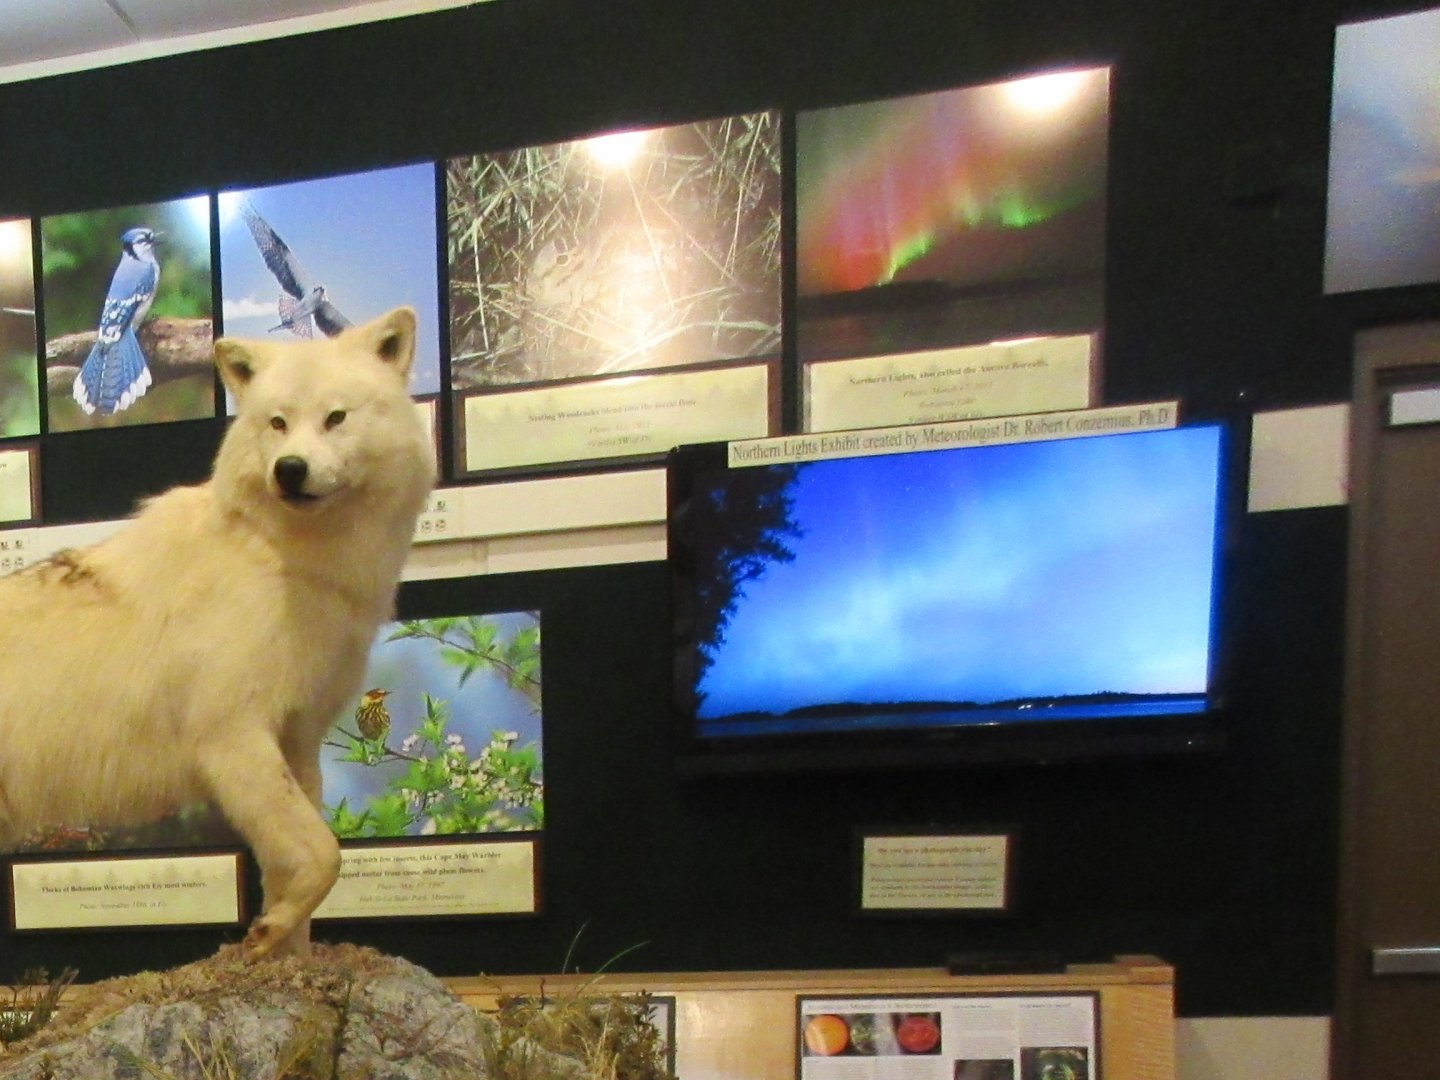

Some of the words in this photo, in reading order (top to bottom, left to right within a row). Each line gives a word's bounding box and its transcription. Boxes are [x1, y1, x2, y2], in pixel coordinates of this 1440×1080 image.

[733, 444, 780, 461] Northern
[784, 439, 818, 460] Lights
[821, 435, 860, 453] Exhibit
[863, 432, 901, 449] created
[905, 431, 917, 450] by
[923, 423, 1000, 445] Meteorologist
[1025, 418, 1064, 436] Robert
[341, 857, 361, 866] pring
